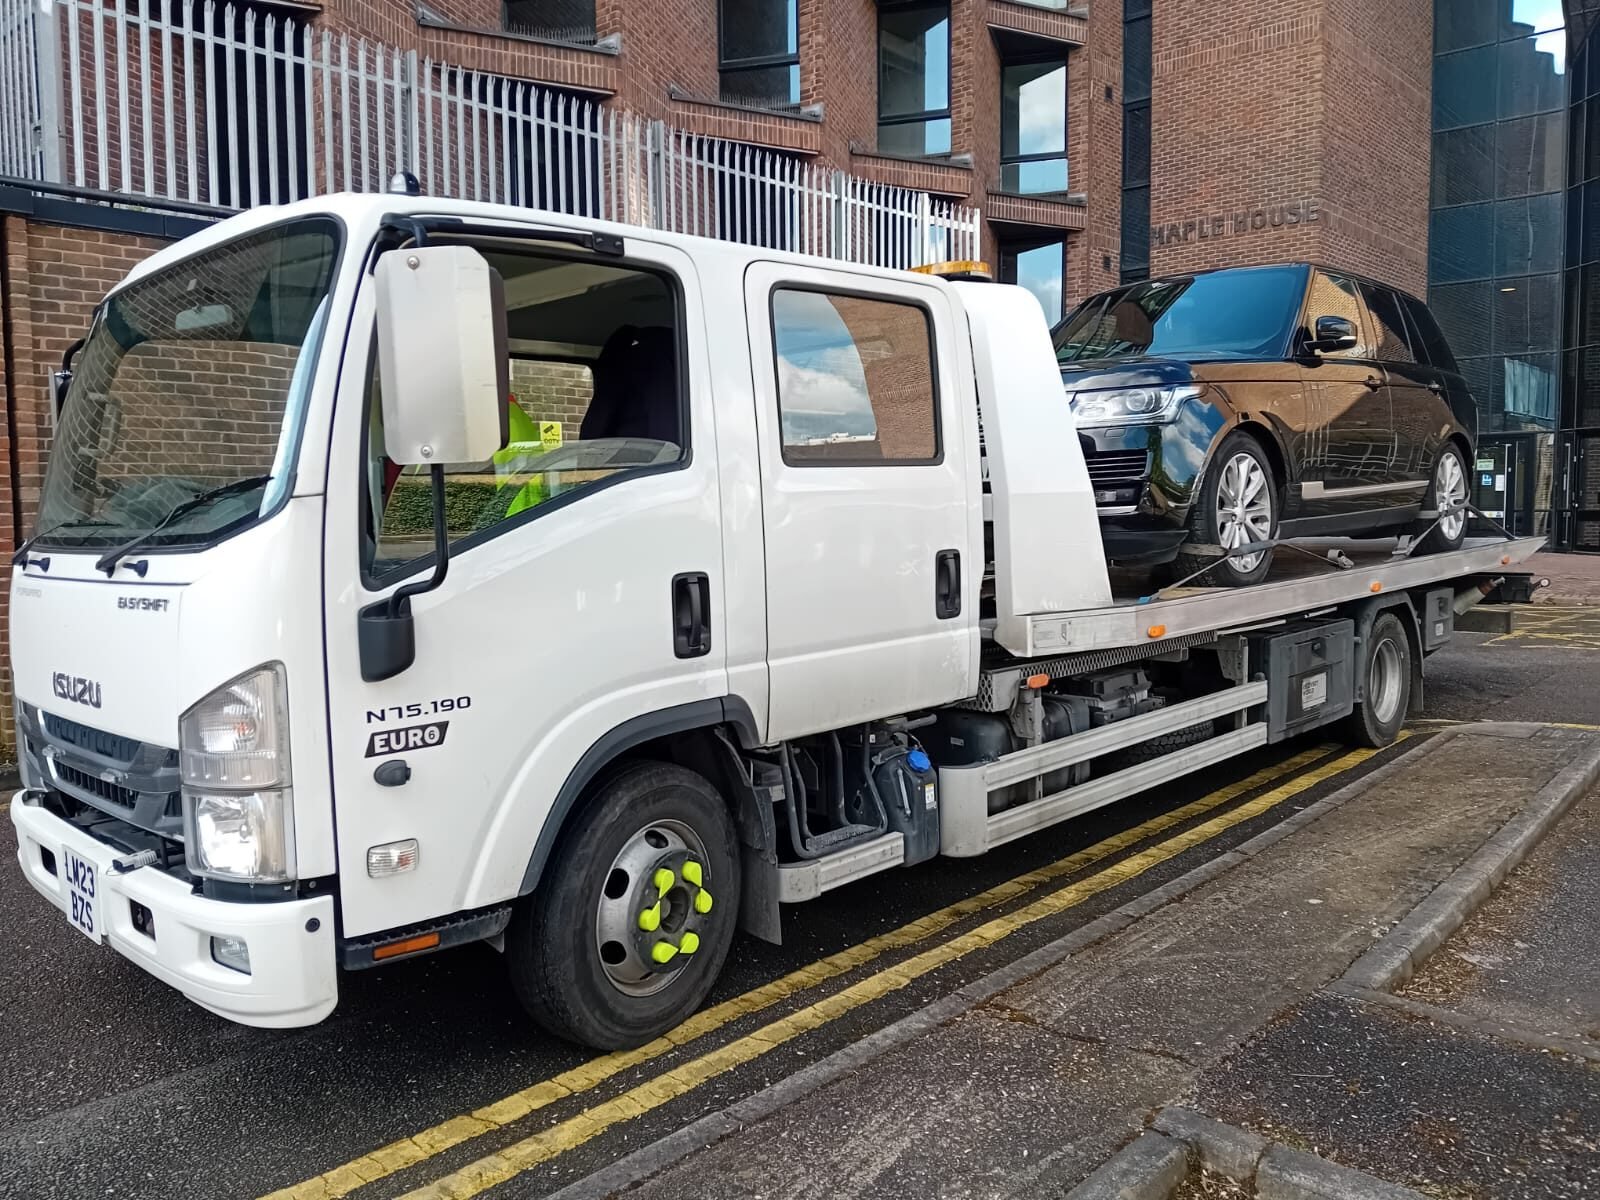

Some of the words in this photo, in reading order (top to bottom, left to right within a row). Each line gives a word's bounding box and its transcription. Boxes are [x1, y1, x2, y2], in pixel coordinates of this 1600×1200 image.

[1151, 217, 1225, 246] MAPLE
[1234, 201, 1319, 234] HOUSE
[118, 597, 170, 612] EASYSHIFT
[53, 671, 102, 709] ISUZU
[366, 696, 471, 724] N75.190
[64, 850, 95, 898] LM23
[70, 889, 94, 934] BZS
